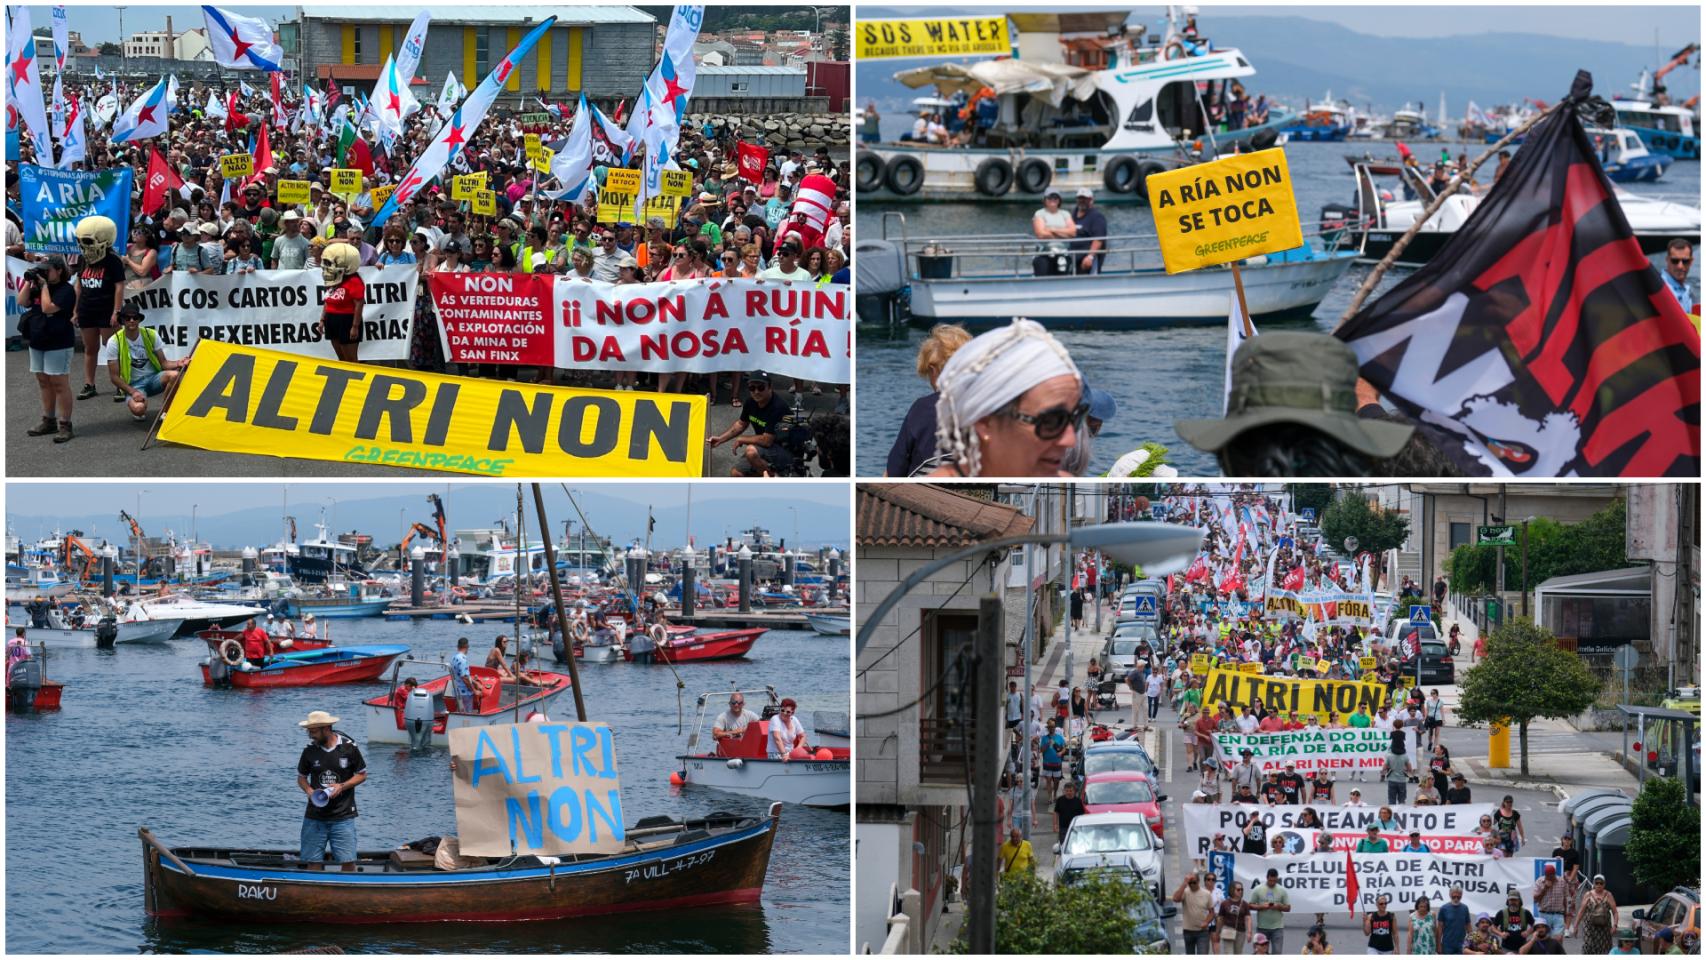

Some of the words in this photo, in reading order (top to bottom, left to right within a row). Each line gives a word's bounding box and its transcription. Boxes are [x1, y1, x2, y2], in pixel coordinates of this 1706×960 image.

[864, 23, 912, 45] SOS
[924, 20, 1000, 42] WATER
[864, 45, 901, 57] BECAUSE
[902, 43, 926, 55] THERE
[223, 156, 249, 166] ALTRI
[339, 178, 354, 186] NON
[459, 178, 479, 187] ALTRI
[666, 171, 686, 181] ALTRI
[668, 180, 683, 188] NON
[36, 181, 54, 203] A
[58, 179, 105, 205] RÍA
[1159, 189, 1176, 208] A
[1179, 177, 1221, 203] RÍA
[1225, 165, 1282, 194] NON
[476, 191, 490, 200] ALTRI
[43, 207, 53, 220] A
[55, 204, 97, 219] NOSA
[1178, 212, 1206, 234] SE
[1209, 197, 1275, 226] TOCA
[1194, 231, 1270, 257] GREENPEACE
[81, 267, 105, 279] ALTRI
[81, 278, 103, 289] NON
[465, 276, 513, 293] NON
[178, 288, 219, 309] COS
[228, 285, 308, 309] CARTOS
[363, 282, 408, 305] LTRI
[441, 292, 456, 305] ÁS
[460, 295, 539, 307] VERTEDURAS
[596, 294, 687, 325] NON
[702, 281, 730, 320] Á
[746, 289, 851, 320] RUIN
[439, 308, 543, 321] CONTAMINANTES
[199, 322, 322, 345] REXENERAS
[459, 322, 545, 335] EXPLOTACIÓN
[452, 336, 470, 345] DA
[473, 336, 508, 347] MINA
[512, 338, 528, 348] DE
[572, 335, 626, 362] DA
[640, 329, 750, 360] NOSA
[765, 318, 831, 358] RÍA
[460, 349, 486, 360] SAN
[490, 350, 520, 361] FINX
[185, 353, 461, 446] ALTRI
[487, 389, 691, 463] NON
[344, 445, 515, 475] GREENPEACE
[1266, 596, 1296, 612] ALTRI
[1337, 600, 1370, 618] FÓRA
[1208, 673, 1300, 712] ALTRI
[1312, 683, 1382, 717] NON
[1218, 735, 1242, 744] EN
[1246, 732, 1325, 745] DEFENSA
[1329, 731, 1356, 741] DO
[1361, 731, 1391, 741] ULL
[472, 725, 617, 788] ALTRI
[1224, 746, 1232, 755] E
[1269, 744, 1298, 756] RÍA
[1303, 744, 1327, 753] DE
[1331, 743, 1393, 753] AROUS
[1263, 761, 1312, 771] ALRI
[1317, 759, 1354, 768] NEN
[506, 785, 626, 849] NON
[1220, 811, 1276, 829] POO
[1444, 812, 1456, 829] E
[1444, 840, 1485, 851] PARA
[1286, 860, 1388, 874] CELULOSA
[1396, 859, 1422, 872] DE
[1428, 861, 1484, 877] ALTRI
[1366, 872, 1395, 888] RÍA
[1401, 876, 1424, 887] DE
[1429, 875, 1500, 894] AROUSA
[238, 883, 278, 901] RAKU
[1363, 889, 1393, 905] RÍO
[1398, 890, 1444, 903] ULLA
